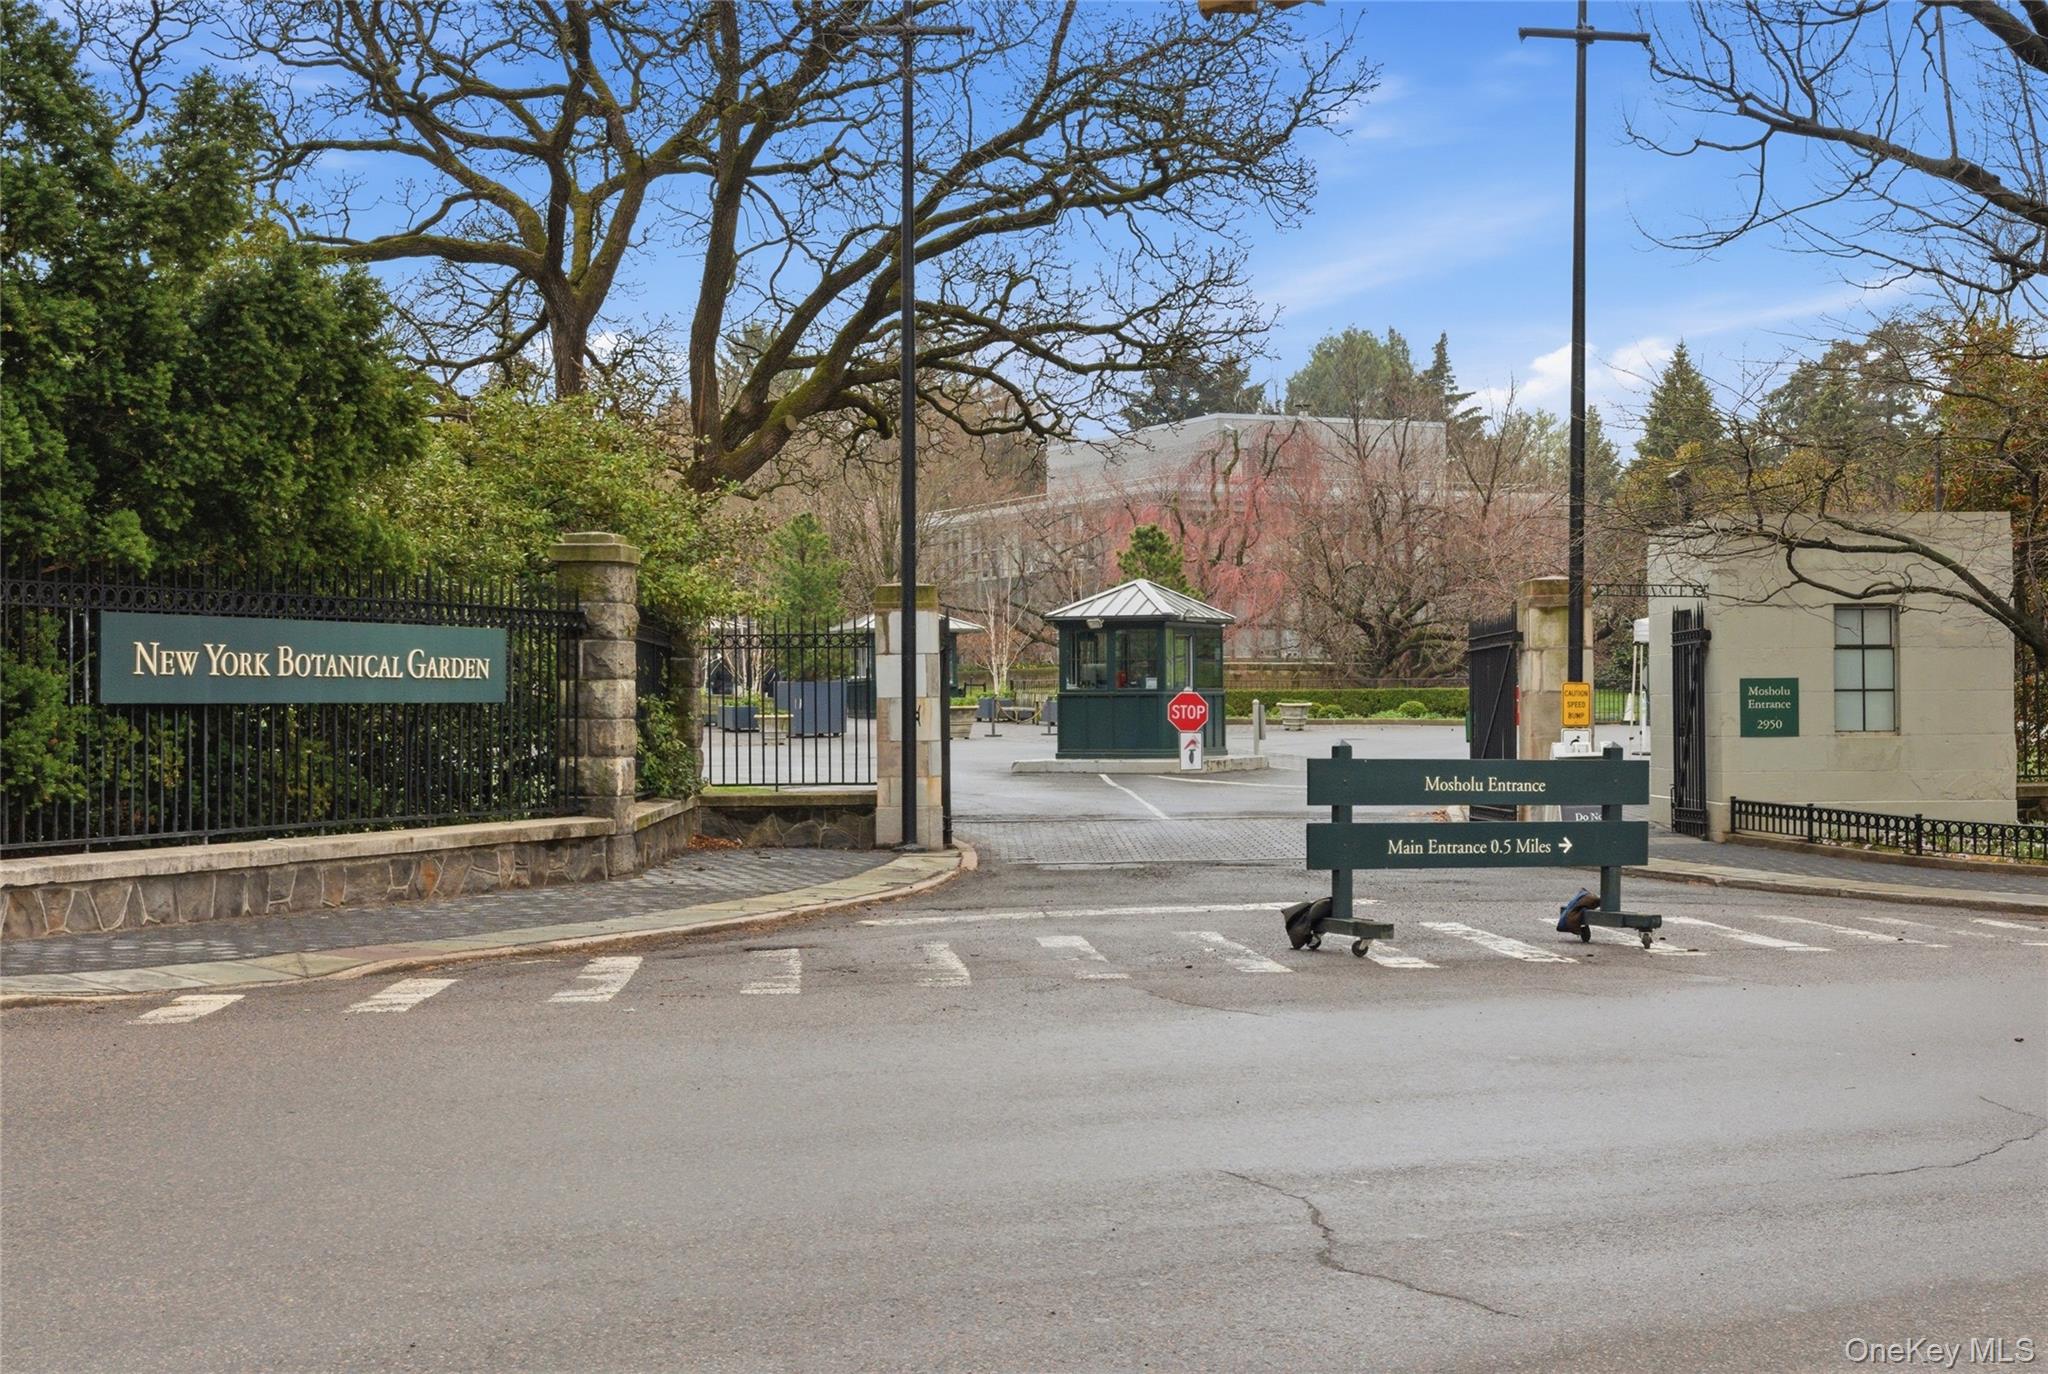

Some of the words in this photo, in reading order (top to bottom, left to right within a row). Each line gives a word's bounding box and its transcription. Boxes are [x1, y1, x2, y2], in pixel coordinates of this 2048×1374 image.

[1748, 686, 1791, 696] Mosholu
[1567, 701, 1586, 709] SPEED
[1748, 699, 1791, 709] Entrance
[1171, 704, 1206, 720] STOP
[1567, 712, 1585, 720] BUMP
[1757, 719, 1783, 730] 2950
[1424, 775, 1484, 793] Mosholu
[1487, 776, 1547, 793] Entrance
[1575, 812, 1589, 821] Do
[1387, 838, 1424, 855] Main
[1428, 839, 1488, 855] Entrance
[1490, 838, 1512, 854] 0.5
[1516, 837, 1551, 854] Miles
